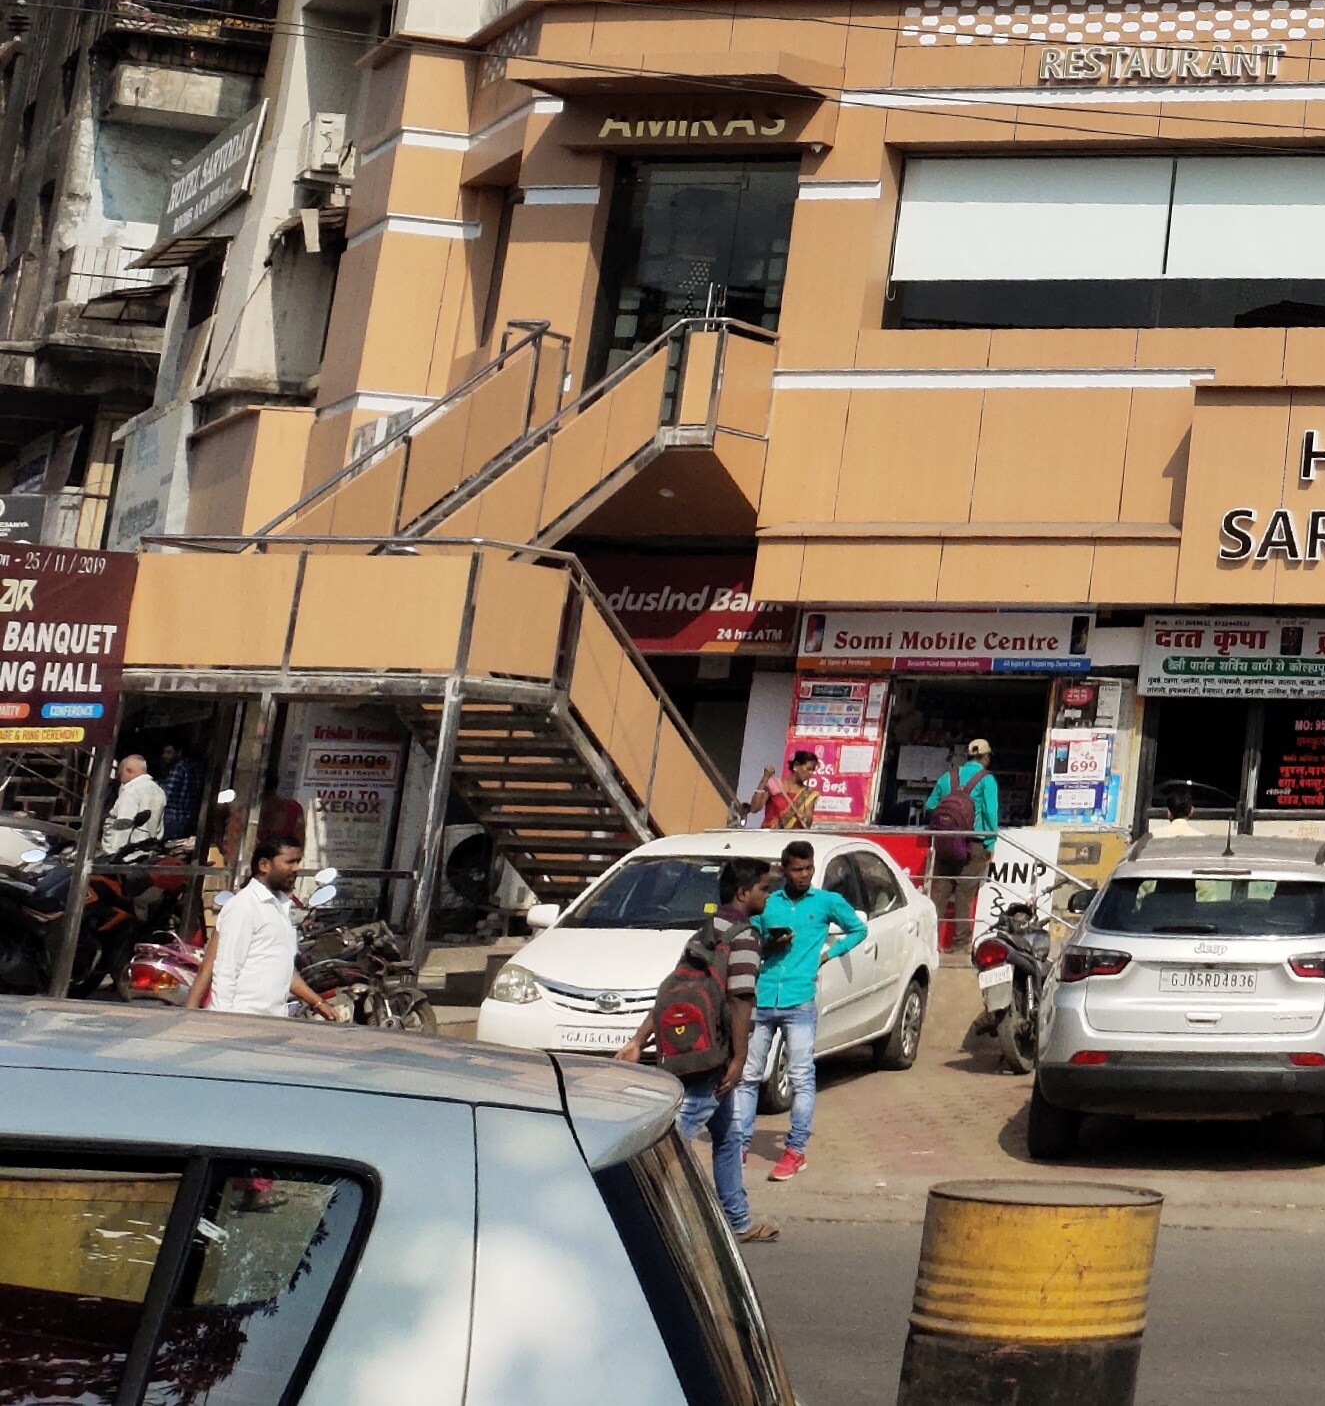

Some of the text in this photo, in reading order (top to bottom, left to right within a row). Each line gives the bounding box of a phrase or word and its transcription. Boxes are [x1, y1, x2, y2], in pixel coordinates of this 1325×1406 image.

[1040, 44, 1286, 80] RESTAURANT
[598, 112, 786, 138] AMIRAS
[3, 621, 118, 655] BANQUET
[716, 628, 783, 641] 24 hrs ATM
[834, 630, 1060, 651] Somi Mobile Centre
[1155, 629, 1205, 648] दत्त
[1213, 630, 1270, 655] कृपा
[42, 662, 103, 693] HALL
[1295, 720, 1313, 730] MO:
[320, 752, 388, 768] orange
[1070, 760, 1098, 772] 699
[316, 800, 381, 814] XEROX
[986, 862, 1047, 884] MNP
[1194, 943, 1228, 955] Jeep
